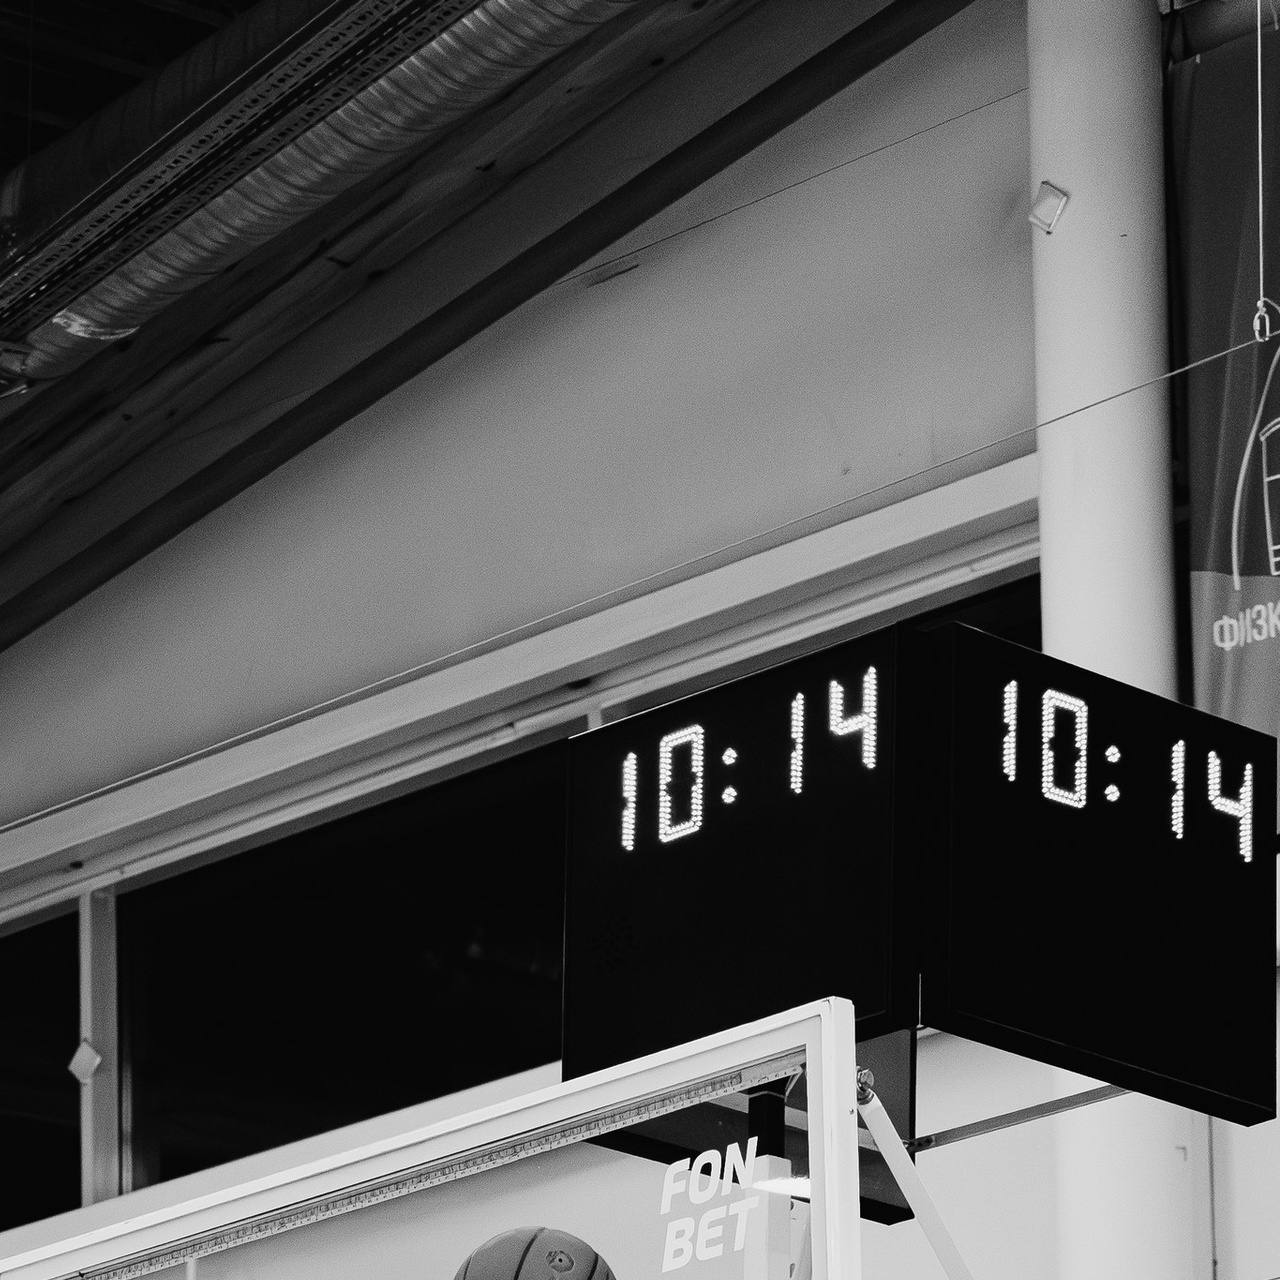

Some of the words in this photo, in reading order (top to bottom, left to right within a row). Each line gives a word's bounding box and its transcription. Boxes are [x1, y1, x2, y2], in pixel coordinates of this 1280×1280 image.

[1213, 600, 1280, 651] ФИЗК
[621, 666, 877, 851] 10:14
[1002, 680, 1254, 863] 10:14
[660, 1136, 758, 1215] FON
[662, 1191, 758, 1273] BET
